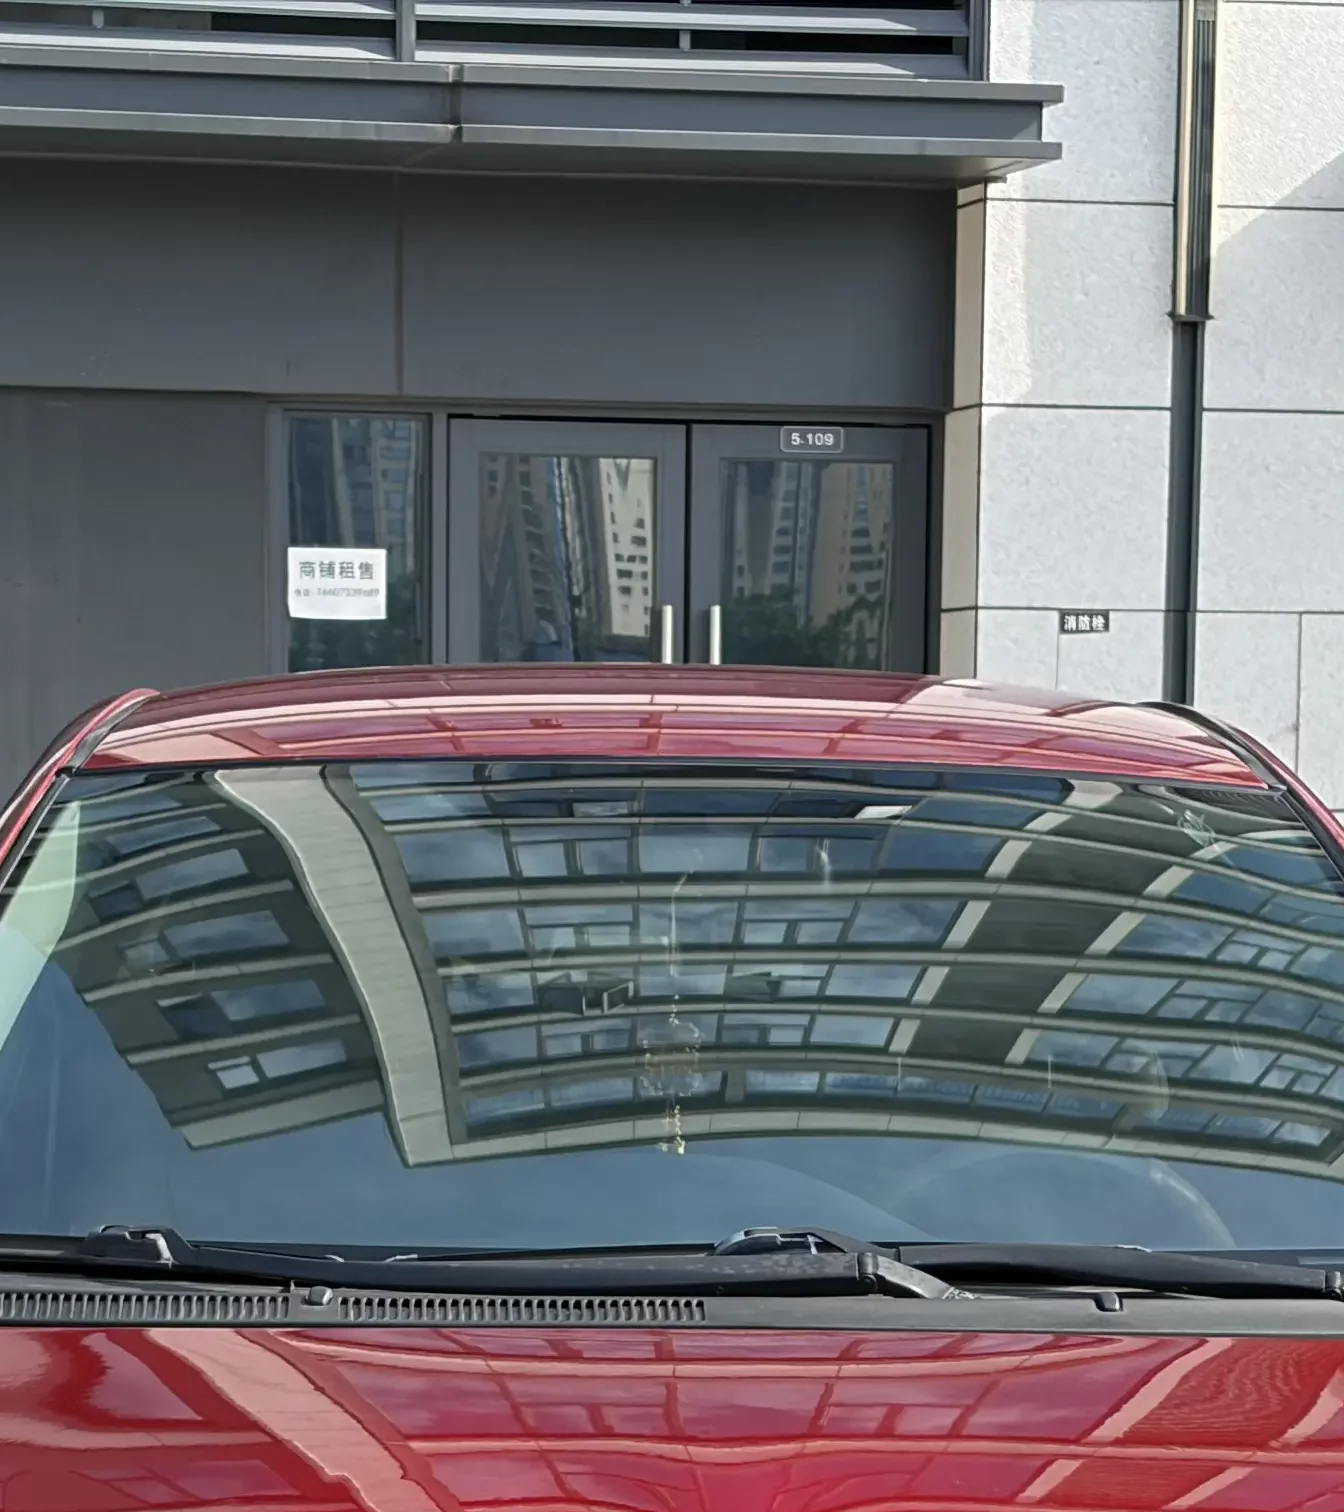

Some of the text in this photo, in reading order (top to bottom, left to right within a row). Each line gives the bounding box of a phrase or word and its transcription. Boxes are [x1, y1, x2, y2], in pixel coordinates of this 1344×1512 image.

[299, 561, 374, 580] 商铺租售
[1063, 614, 1106, 632] 消防栓
